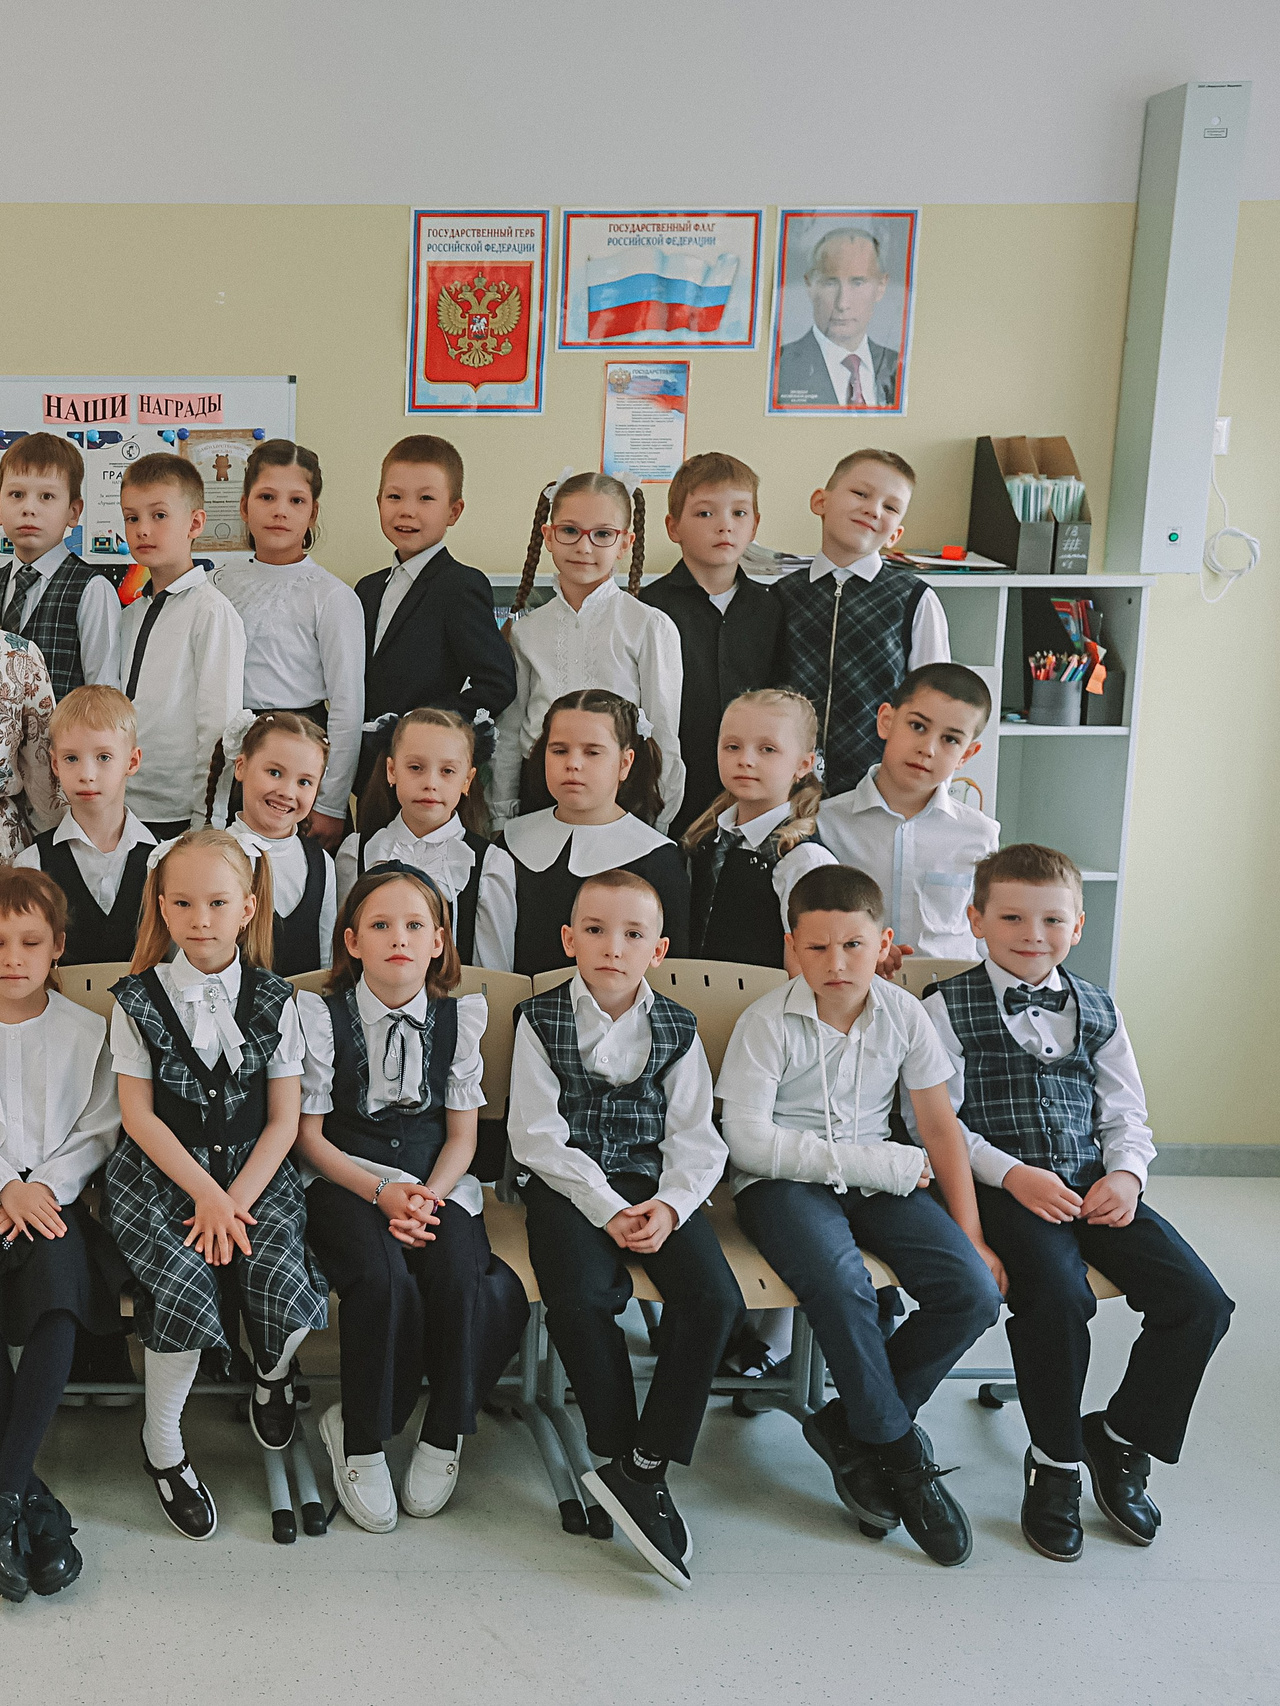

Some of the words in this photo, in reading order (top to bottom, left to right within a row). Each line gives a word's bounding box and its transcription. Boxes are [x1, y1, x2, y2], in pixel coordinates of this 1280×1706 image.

[427, 226, 513, 238] ГОСУДАРСТВЕННЫЙ
[515, 228, 536, 237] ГЕРБ
[609, 221, 691, 233] ГОСУДАРСТВЕННЫЙ
[693, 222, 716, 232] ФЛАГ
[607, 234, 663, 246] РОССИЙСКОЙ
[665, 237, 716, 248] ФЕДЕРАЦИИ
[427, 241, 483, 252] РОССИЙСКОЙ
[484, 243, 535, 254] ФЕДЕРАЦИИ
[45, 394, 128, 422] НАШИ
[139, 394, 222, 419] НАГРАДЫ
[102, 470, 123, 480] ГРА
